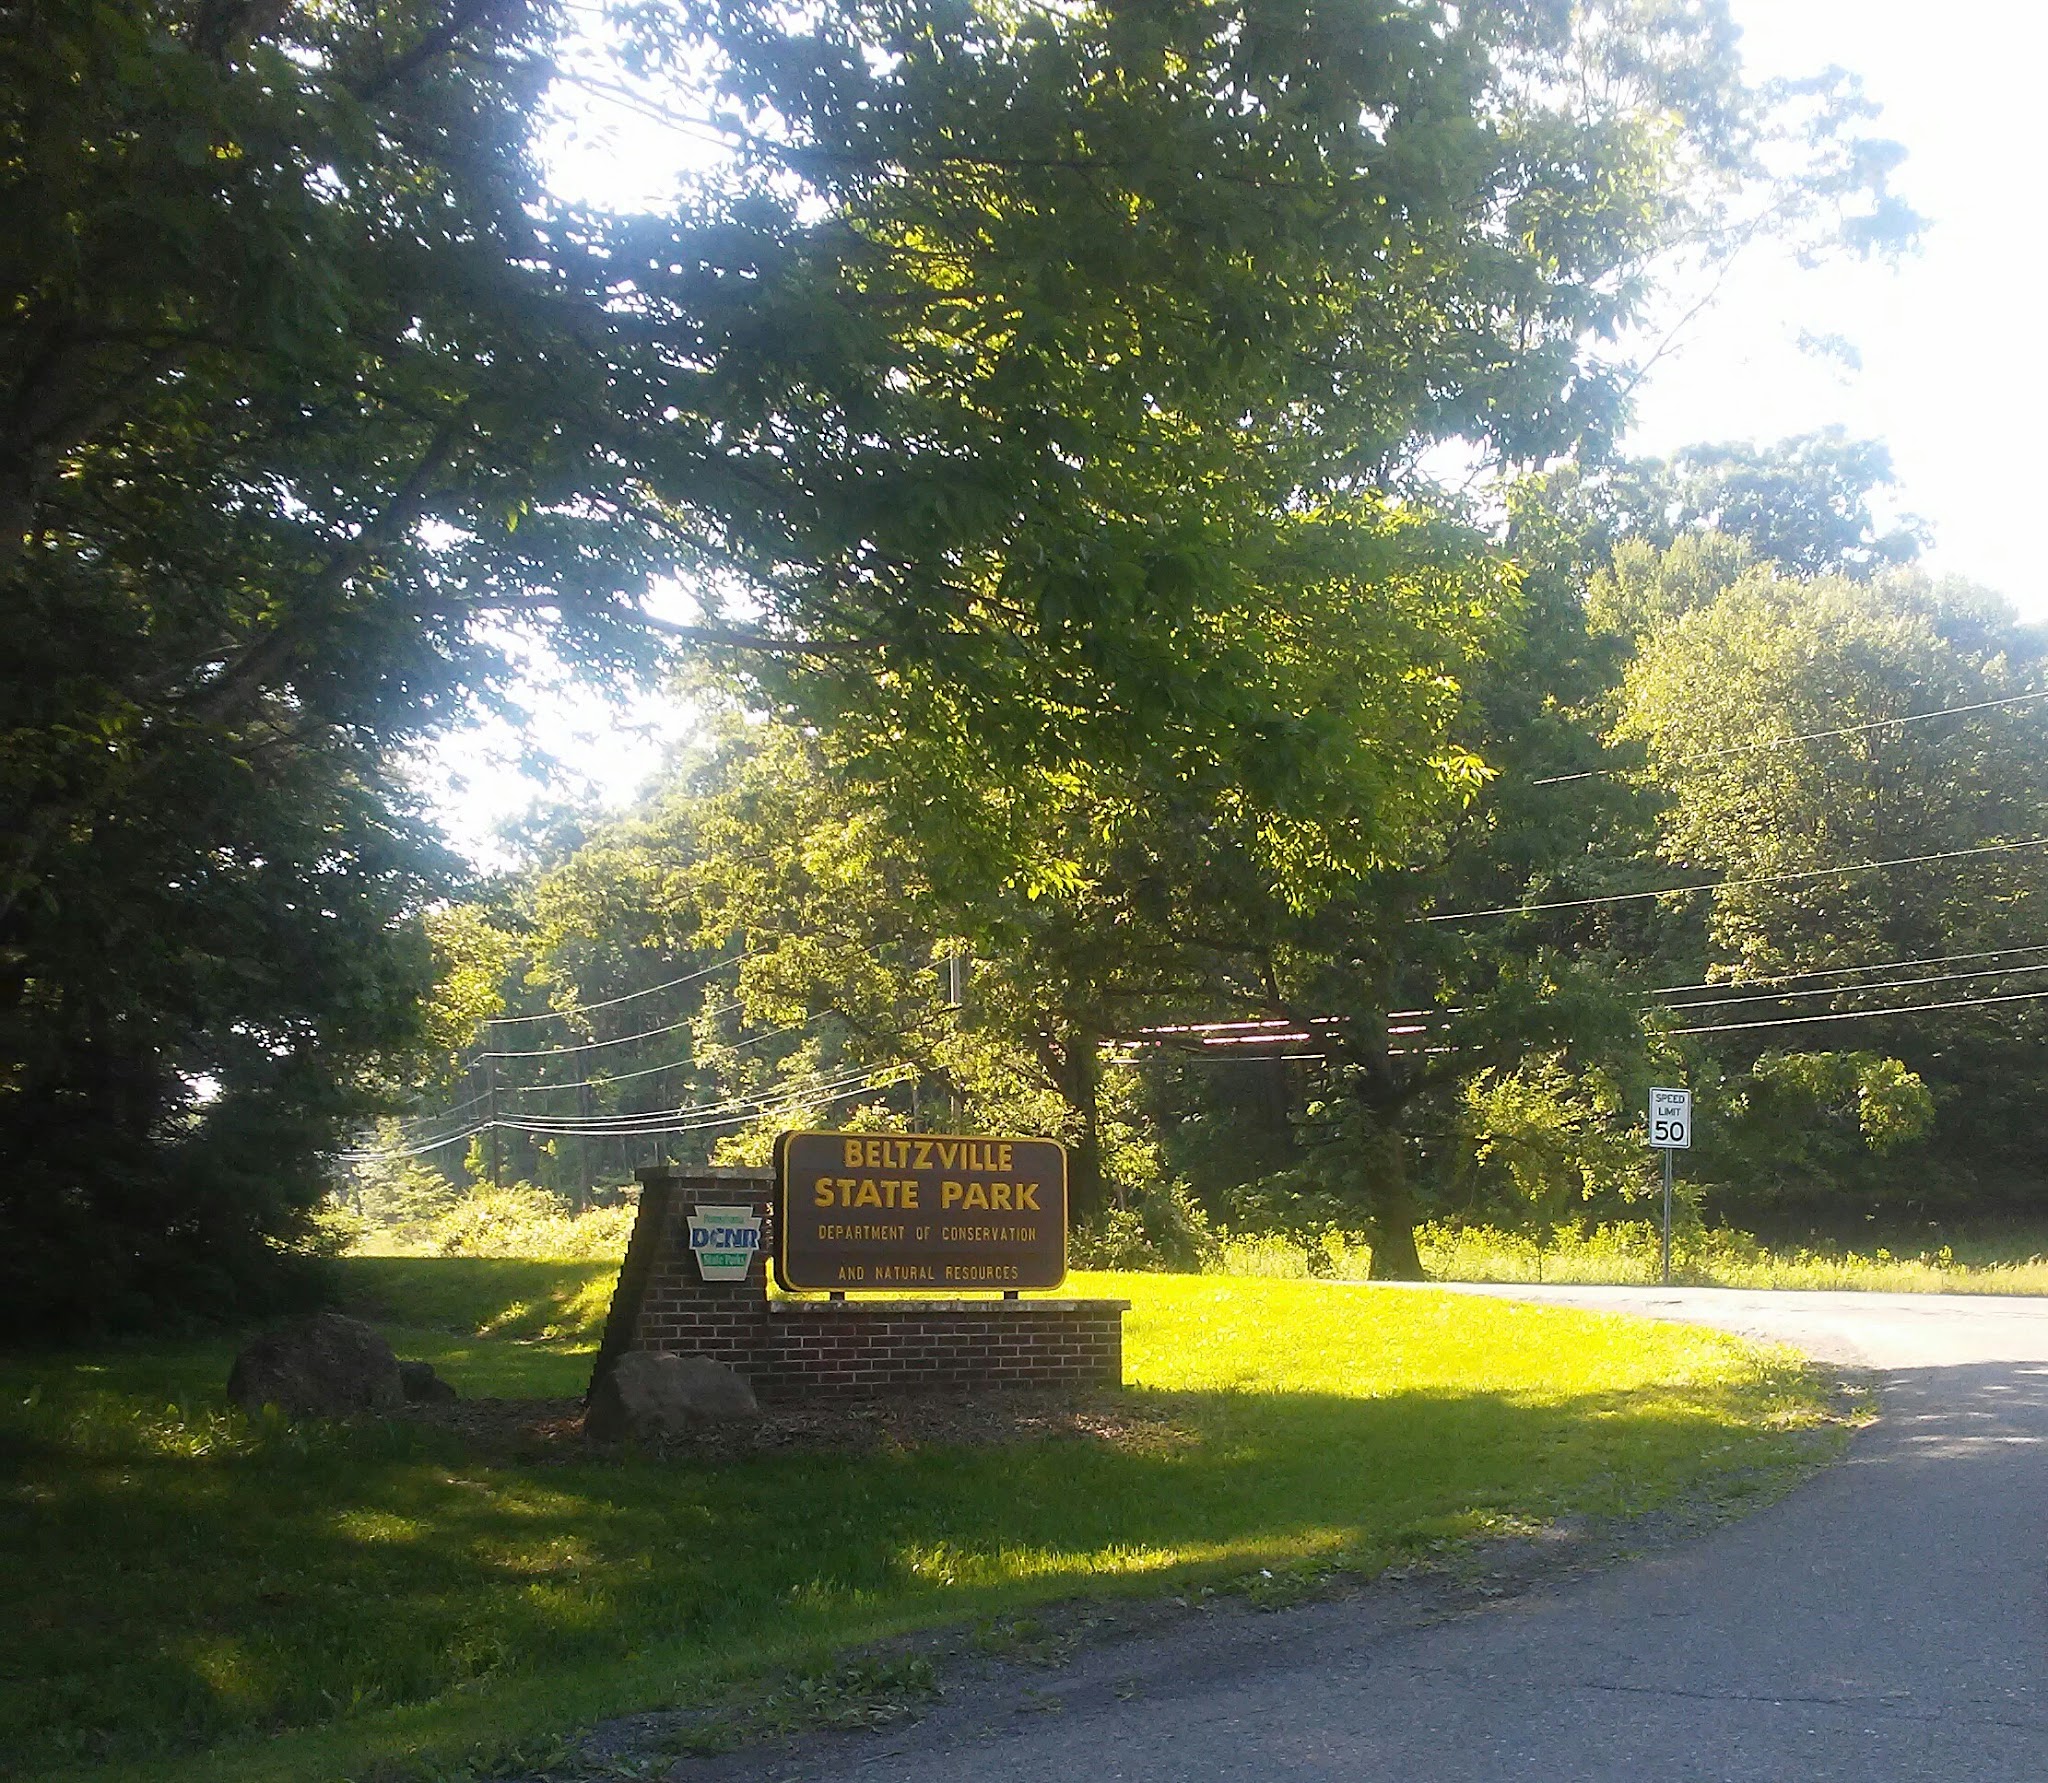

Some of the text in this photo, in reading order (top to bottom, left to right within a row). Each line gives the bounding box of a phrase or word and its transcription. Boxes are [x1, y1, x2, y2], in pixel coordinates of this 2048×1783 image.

[1655, 1094, 1685, 1103] SPEED
[1658, 1107, 1681, 1116] LIMIT
[1655, 1121, 1684, 1141] 50
[844, 1140, 1013, 1172] BELTZVILLE
[814, 1178, 1041, 1211] STATE PARK
[692, 1227, 758, 1248] DCNR
[818, 1224, 1036, 1241] DEPARTMENT OF CONSERVATION
[838, 1266, 1018, 1280] AND NATURAL RESOURCES
